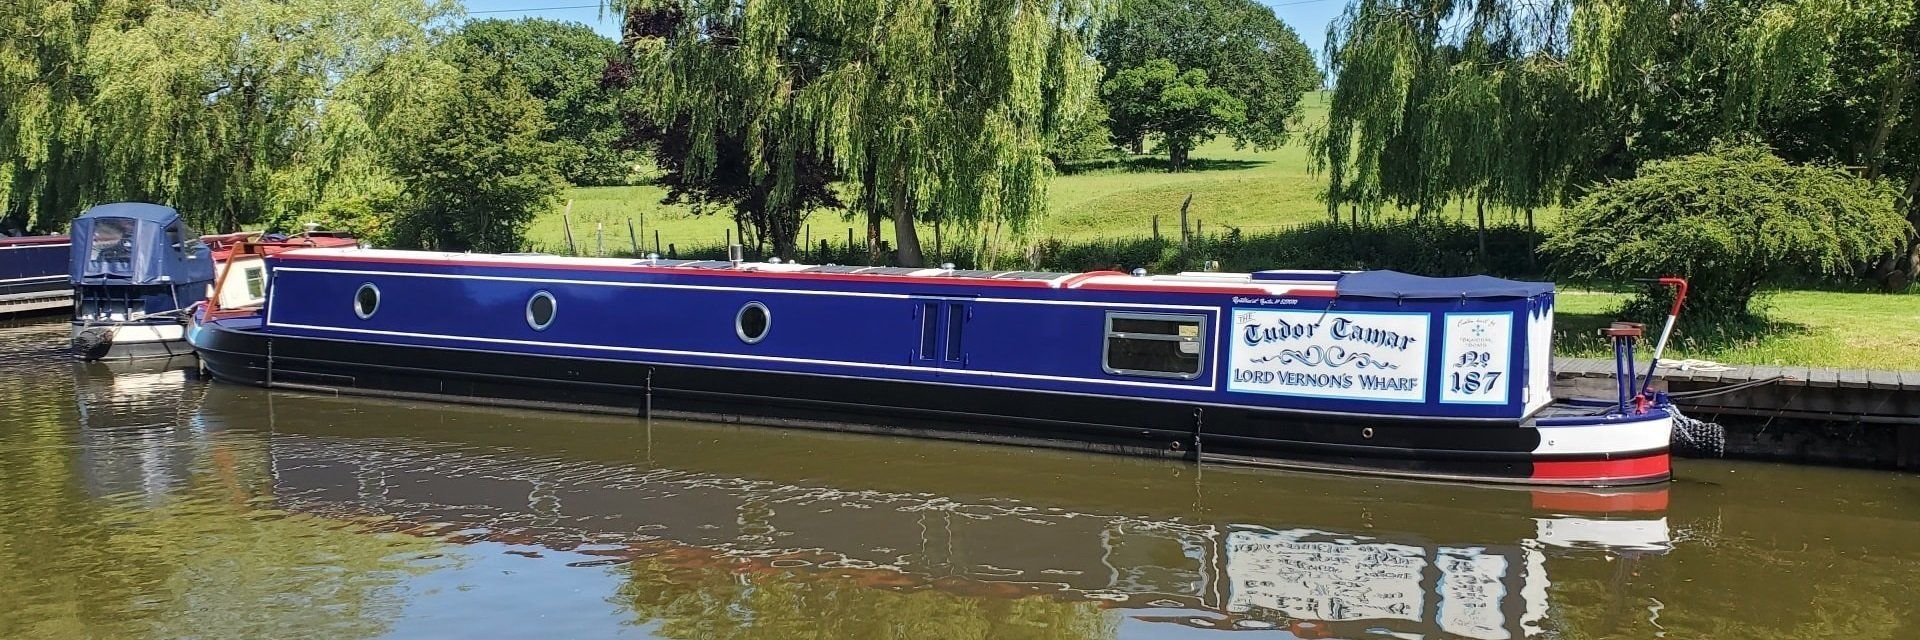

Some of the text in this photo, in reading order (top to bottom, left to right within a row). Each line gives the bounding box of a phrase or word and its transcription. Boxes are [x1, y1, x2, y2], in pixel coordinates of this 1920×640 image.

[1237, 313, 1254, 323] THE
[1244, 317, 1416, 351] Tudor Tamar
[1234, 368, 1418, 391] LORD VERNON'S WHARF
[1451, 371, 1502, 394] 187
